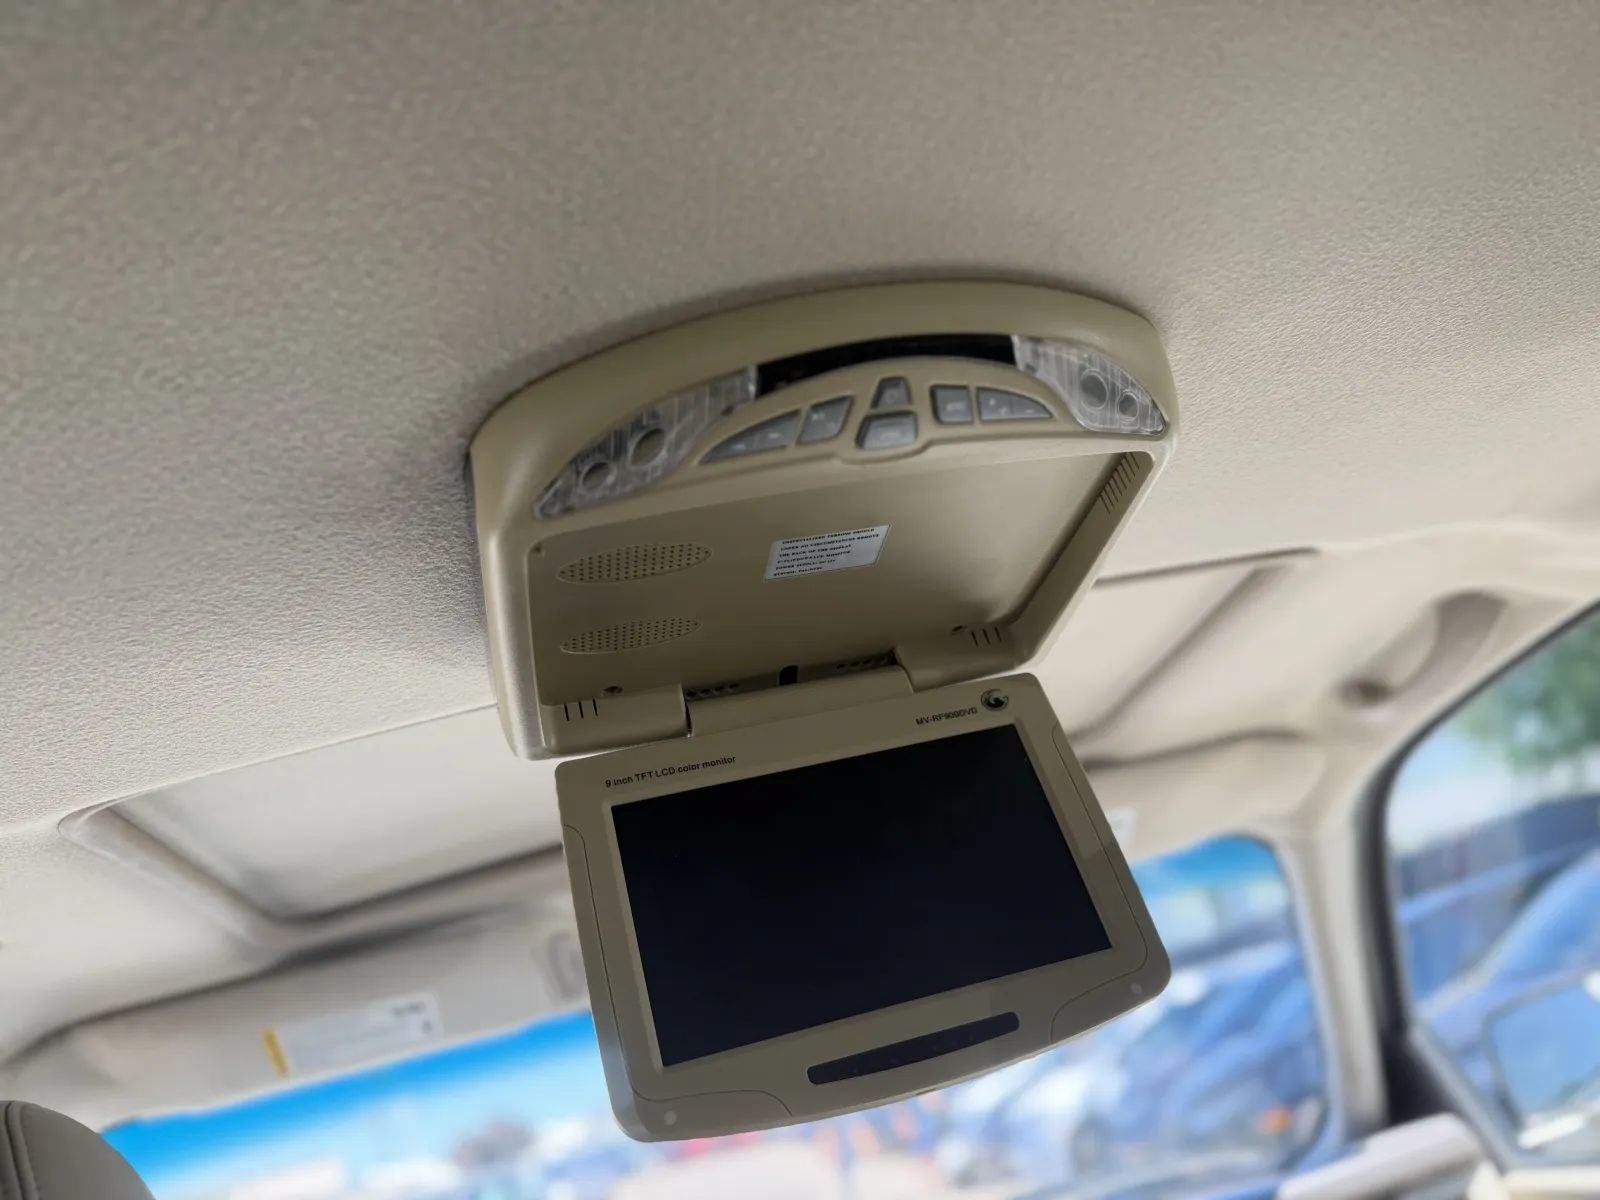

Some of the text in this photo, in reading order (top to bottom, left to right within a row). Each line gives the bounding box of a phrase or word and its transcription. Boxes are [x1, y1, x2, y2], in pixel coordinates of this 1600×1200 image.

[605, 756, 736, 788] 9 inch TFT LCD color monitor
